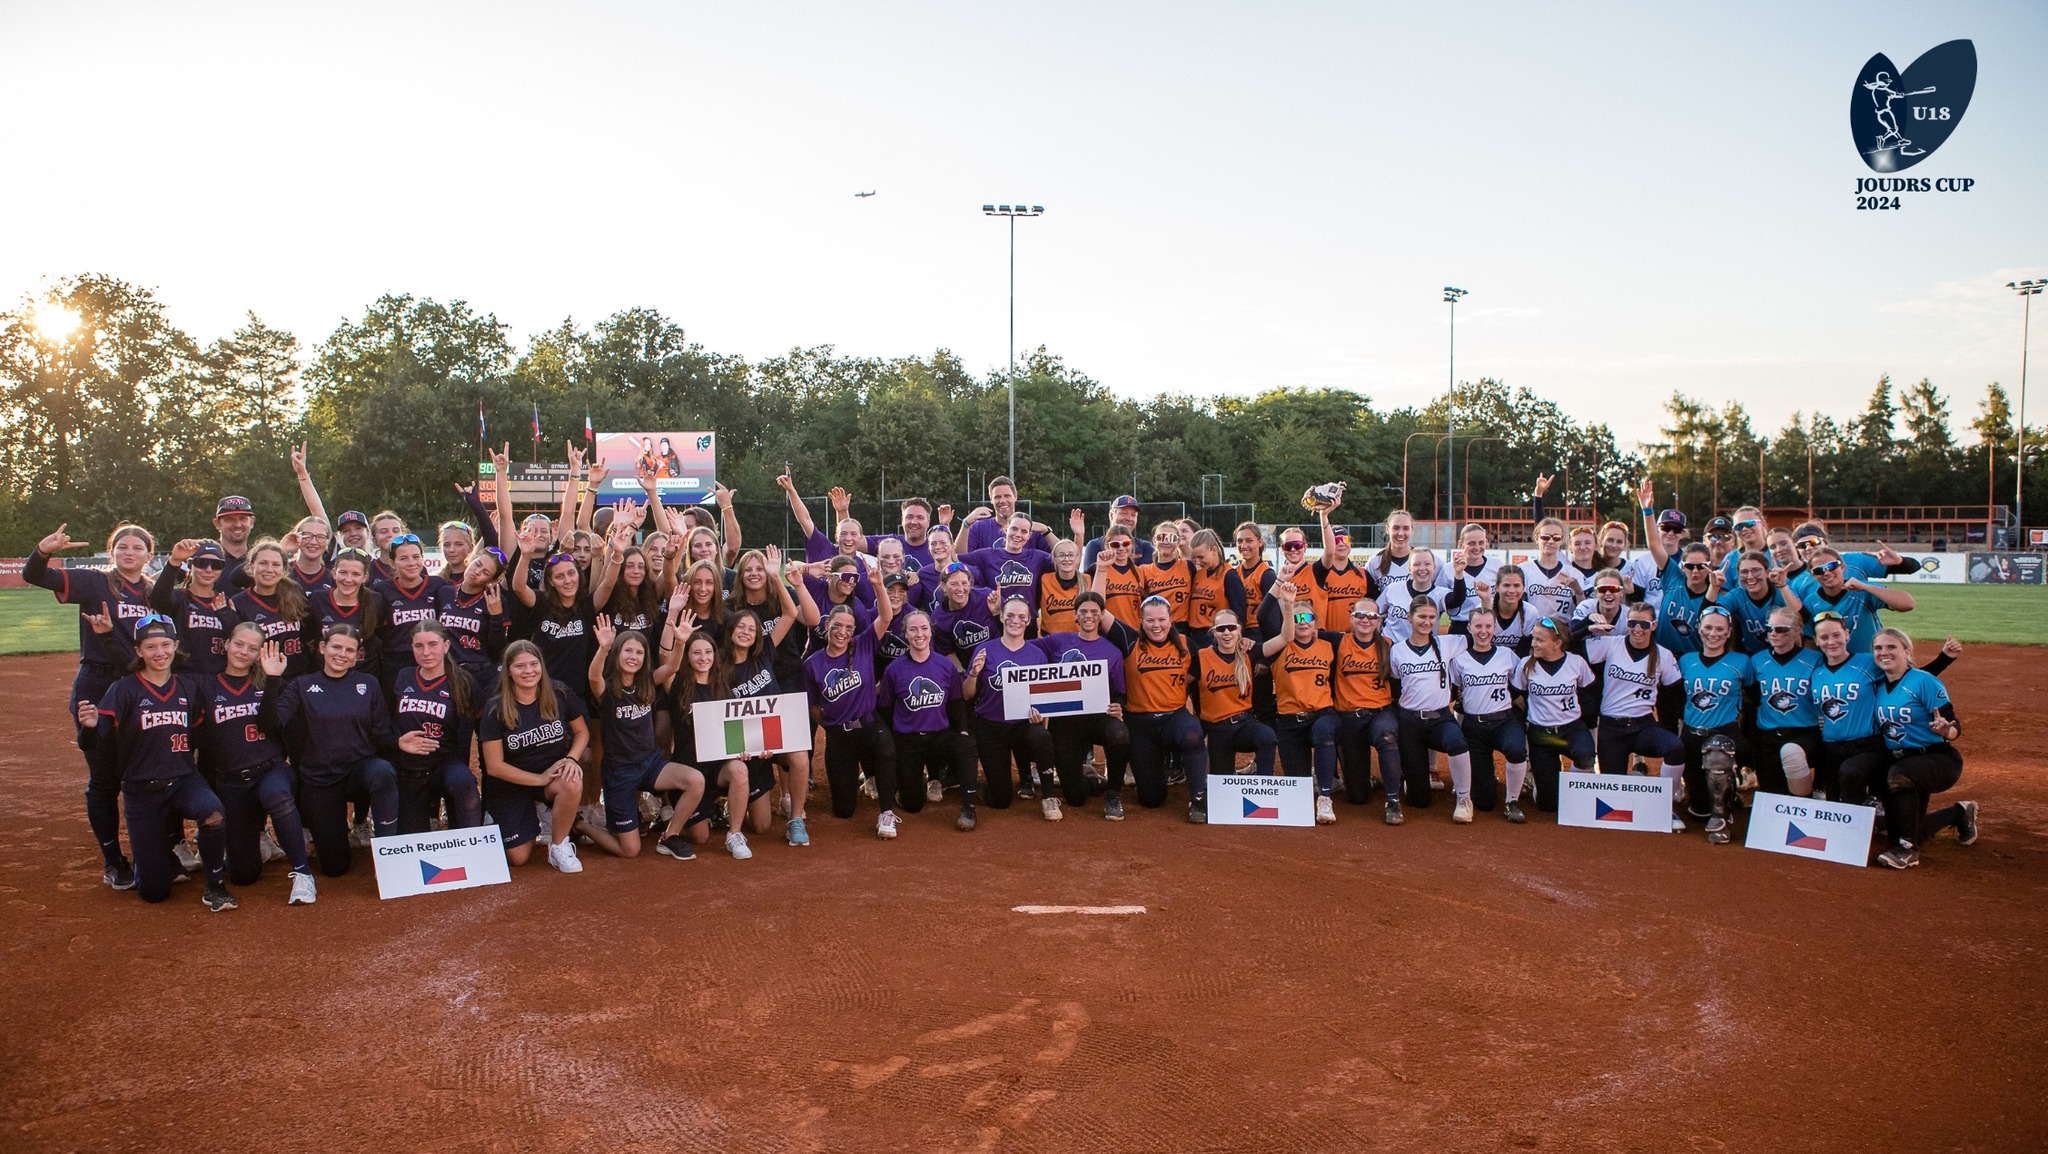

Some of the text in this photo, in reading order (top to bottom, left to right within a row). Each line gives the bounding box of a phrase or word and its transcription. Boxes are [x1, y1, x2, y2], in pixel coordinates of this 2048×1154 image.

[1529, 583, 1575, 597] Piranhas
[1046, 593, 1075, 610] Joud
[1556, 599, 1571, 614] 72
[1199, 604, 1217, 617] 97
[1667, 601, 1700, 628] CAT
[460, 634, 482, 651] 44
[1286, 652, 1329, 668] Joudrs
[1007, 664, 1102, 683] NEDERLAND
[1170, 674, 1186, 687] 75
[1463, 672, 1508, 687] Piranhas
[1490, 688, 1506, 702] 45
[1529, 682, 1576, 697] Piranhas
[1684, 677, 1732, 696] CATS
[1760, 677, 1810, 696] CATS
[1812, 683, 1860, 705] CATS
[399, 696, 447, 720] ČESKO
[725, 698, 778, 718] ITALY
[911, 693, 944, 707] RAVENS
[1560, 696, 1576, 712] 12
[141, 710, 188, 731] ČESKO
[215, 702, 261, 724] ČESK
[1877, 706, 1913, 724] ATS
[422, 722, 444, 738] 13
[508, 720, 564, 750] STARS
[1222, 778, 1298, 787] JOUDRS PRAGUE
[1568, 781, 1662, 793] PIRANHAS BEROUN
[1241, 788, 1280, 796] ORANGE
[1775, 804, 1852, 824] CATS BRNO
[379, 844, 414, 856] Czech
[417, 839, 467, 853] Republic
[470, 834, 497, 846] U-15
